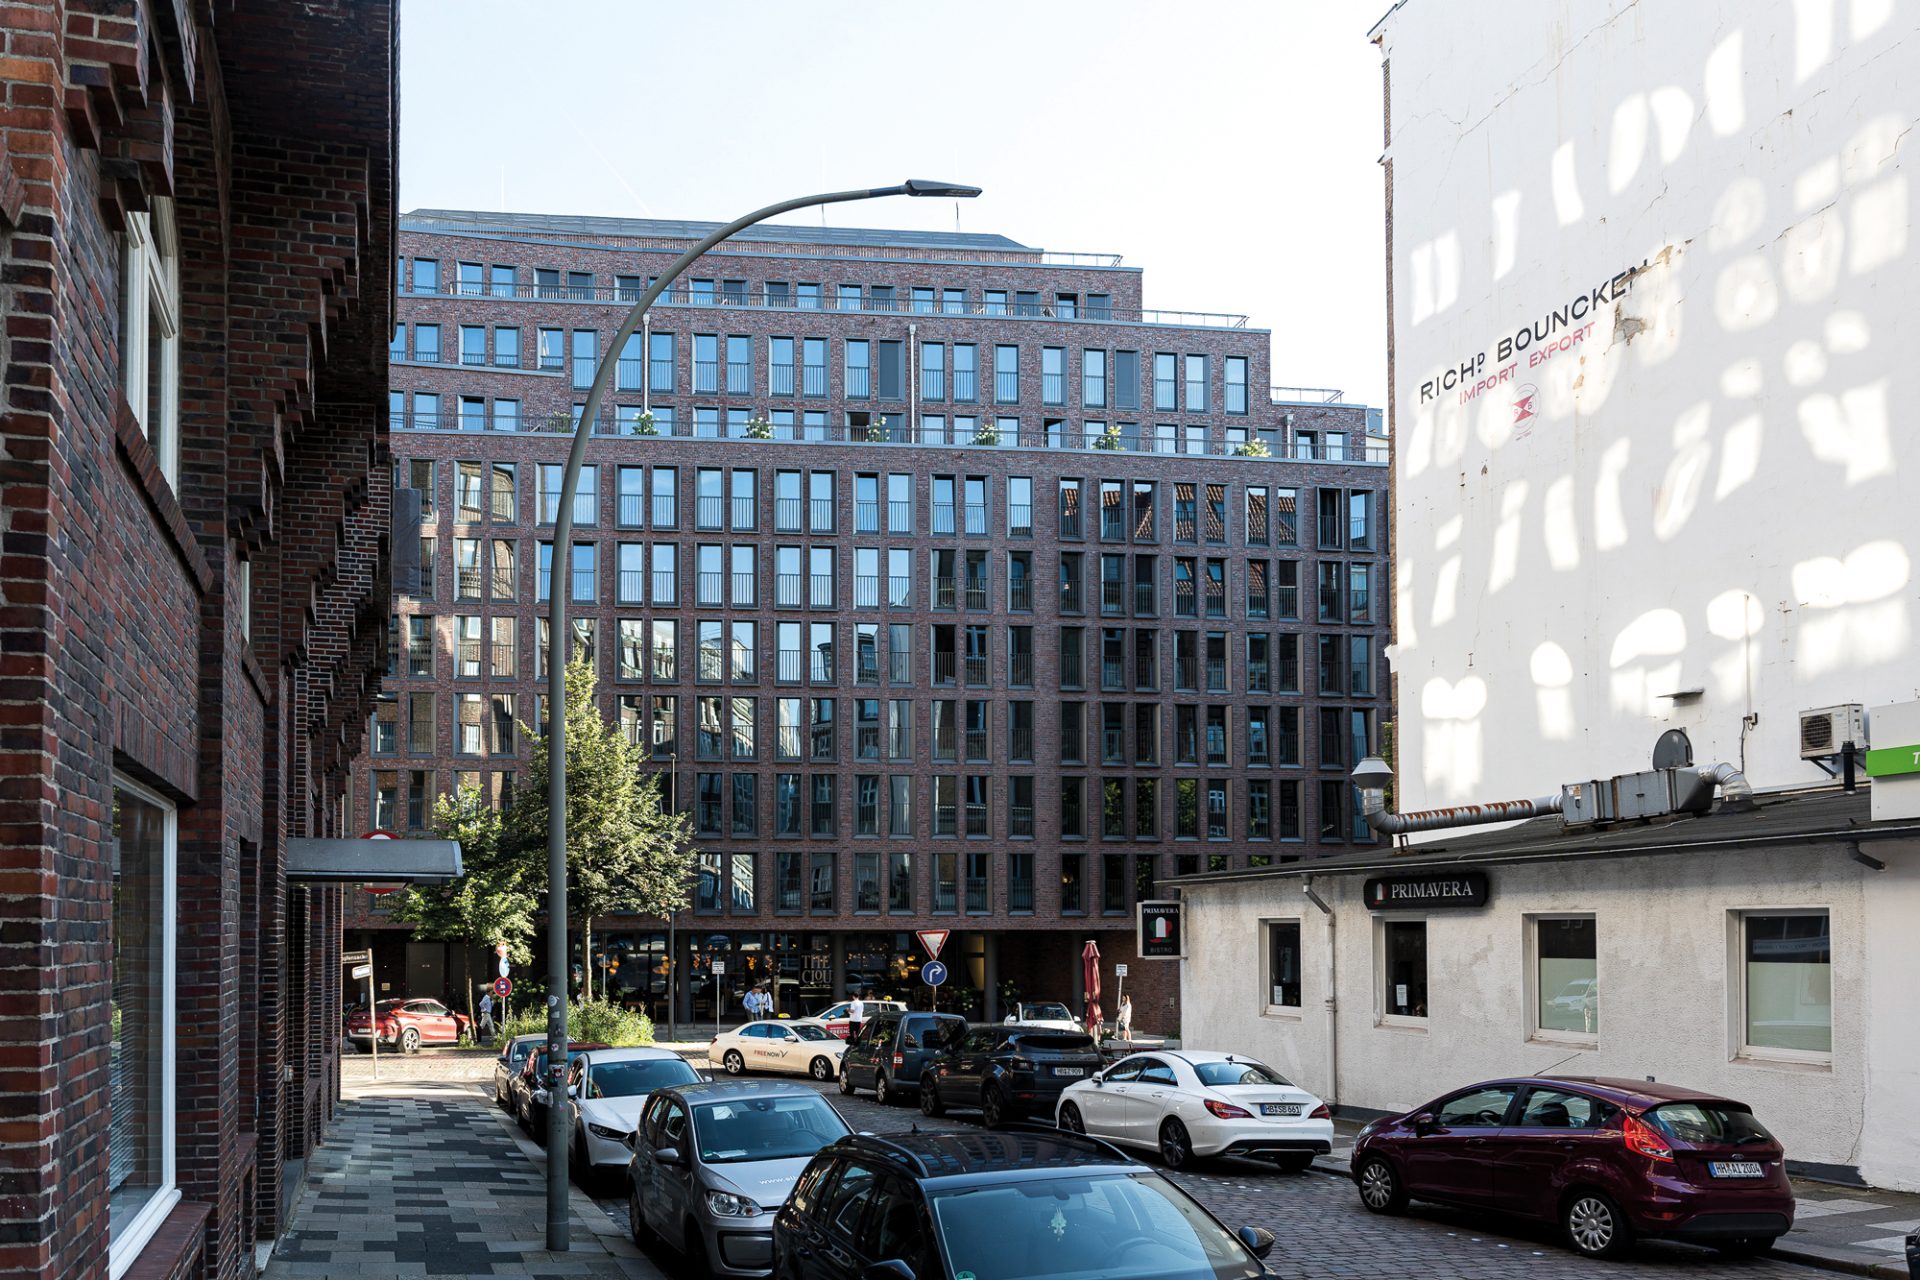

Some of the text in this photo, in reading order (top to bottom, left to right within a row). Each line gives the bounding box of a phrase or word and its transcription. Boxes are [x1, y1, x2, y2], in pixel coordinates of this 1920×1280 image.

[1459, 321, 1595, 405] IMPORT EXPORT
[1391, 880, 1473, 899] PRIMAVERA
[801, 953, 832, 969] THE
